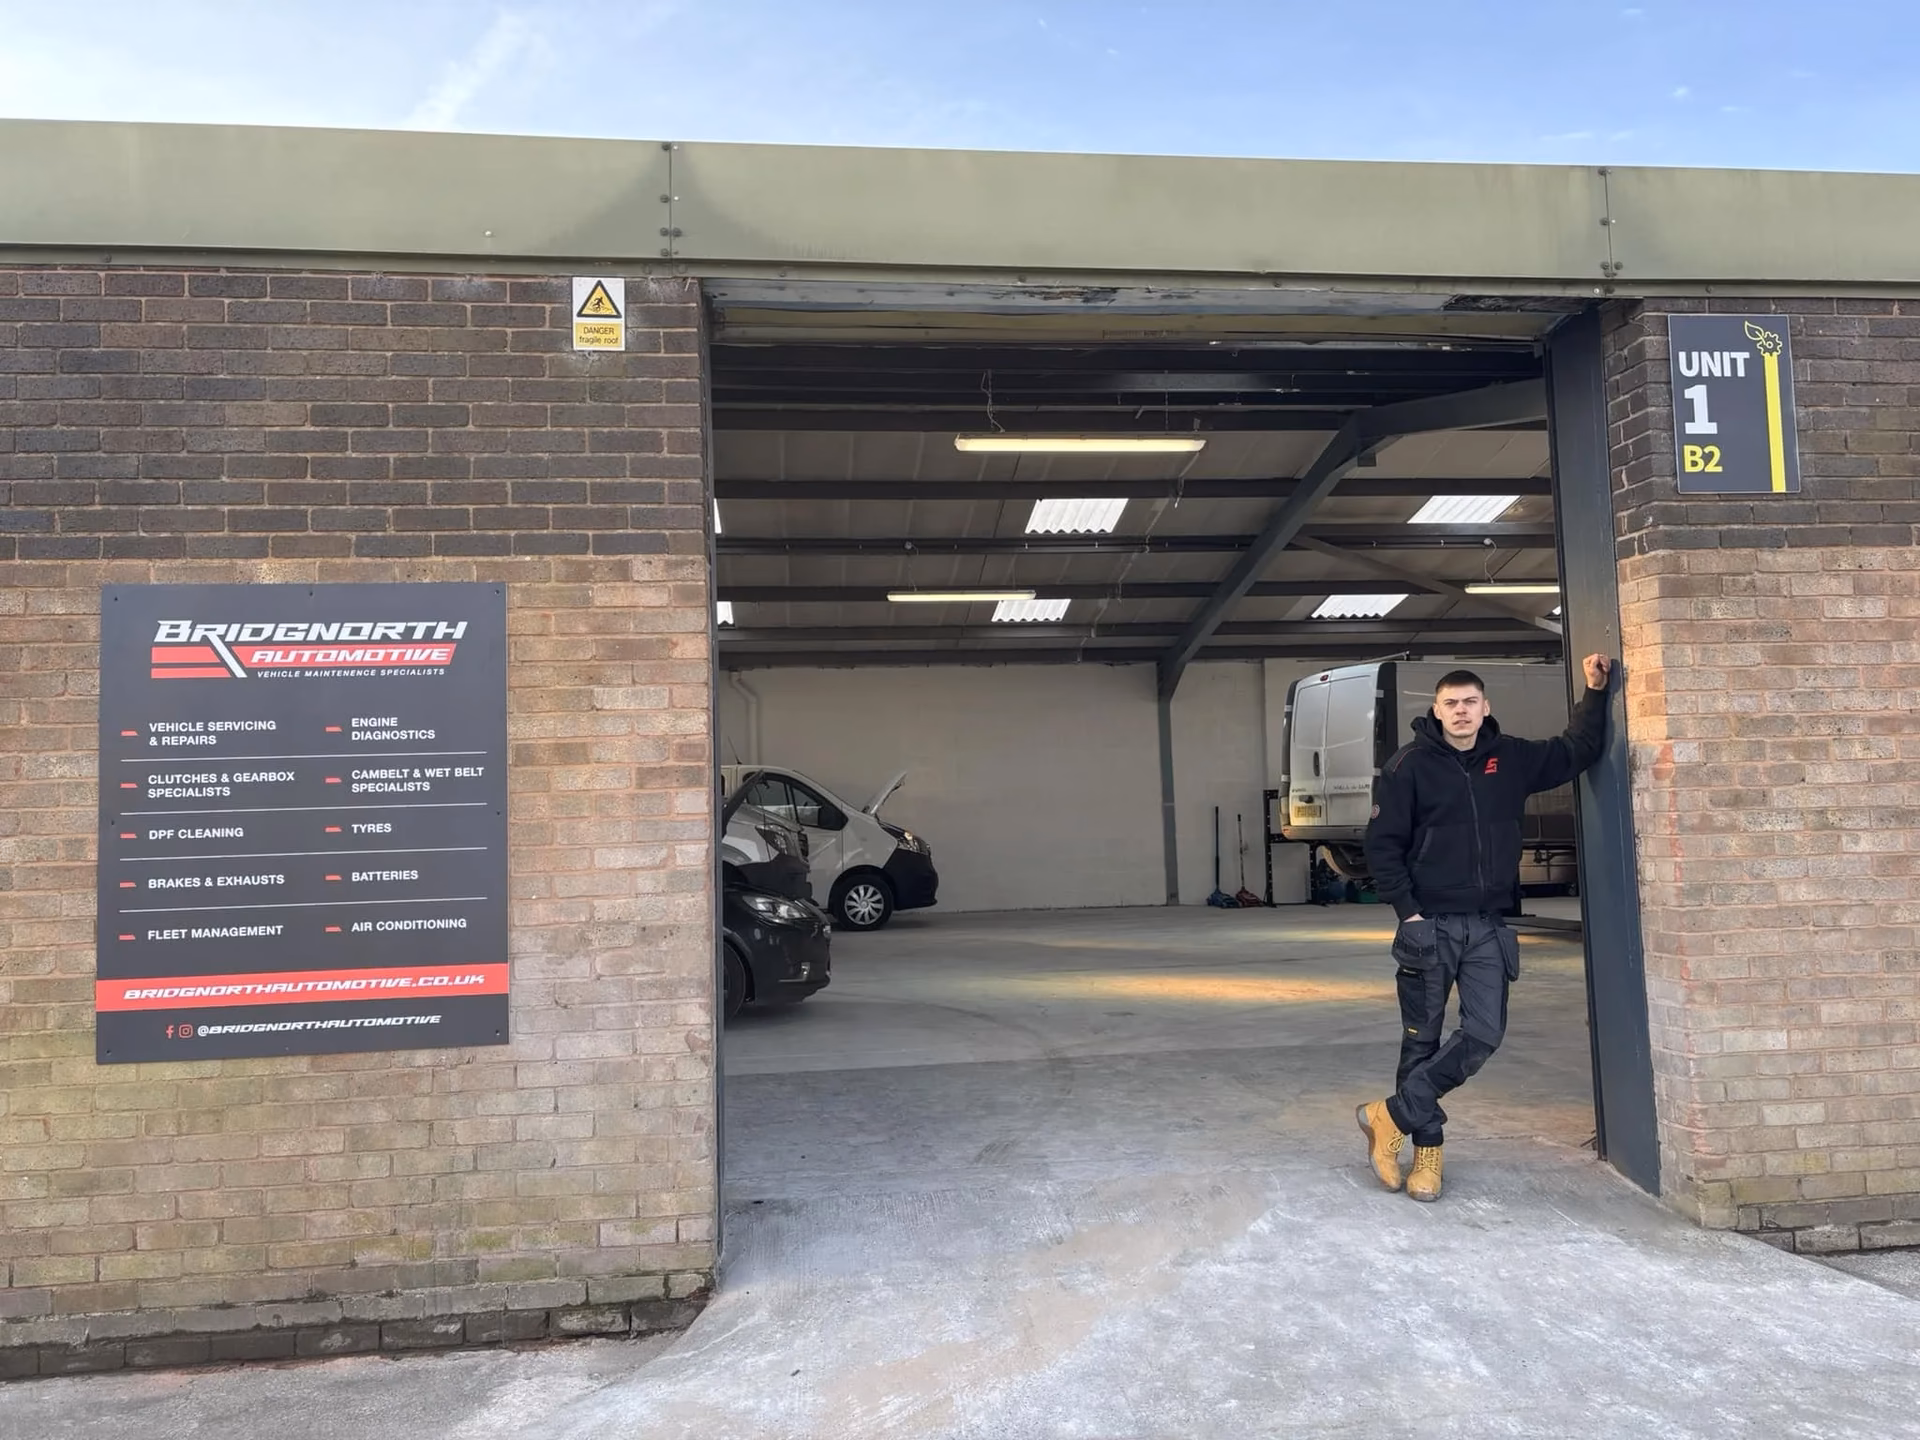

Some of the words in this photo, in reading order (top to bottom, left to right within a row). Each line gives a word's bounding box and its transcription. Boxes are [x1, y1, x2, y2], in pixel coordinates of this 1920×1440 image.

[583, 326, 615, 335] DANGER
[579, 336, 601, 345] fragile
[1678, 351, 1750, 377] UNIT
[1684, 384, 1718, 434] 1
[1683, 444, 1723, 473] B2
[153, 620, 468, 643] BRIDGNORTH
[251, 647, 450, 663] AUTOMOTIVE
[257, 670, 301, 678] VEHICLE
[304, 669, 376, 678] MAINTENENCE
[380, 668, 445, 677] SPECIALISTS
[149, 722, 204, 732] VEHICLE
[207, 720, 277, 732] SERVICING
[351, 717, 399, 728] ENGINE
[149, 737, 158, 746] &
[162, 735, 217, 746] REPAIRS
[351, 729, 436, 741] DIAGNOSTICS
[148, 773, 218, 785] CLUTCHES
[221, 773, 230, 783] &
[233, 771, 295, 783] GEARBOX
[351, 769, 411, 780] CAMBELT
[413, 769, 422, 778] &
[425, 768, 452, 778] WET
[454, 767, 485, 778] BELT
[148, 787, 231, 798] SPECIALISTS
[351, 782, 431, 793] SPECIALISTS
[149, 830, 174, 840] DPF
[178, 828, 244, 839] CLEANING
[351, 823, 392, 833] TYRES
[148, 877, 202, 889] BRAKES
[204, 877, 214, 887] &
[217, 874, 286, 887] EXHAUSTS
[351, 870, 419, 882] BATTERIES
[351, 921, 373, 932] AIR
[376, 918, 467, 931] CONDITIONING
[148, 929, 188, 941] FLEET
[191, 925, 284, 939] MANAGEMENT
[123, 974, 485, 1000] BRIDGNORTHAUTOMOTIVE.CO.UK
[197, 1014, 442, 1037] @BRIDGNORTHAUTOMOTIVE
